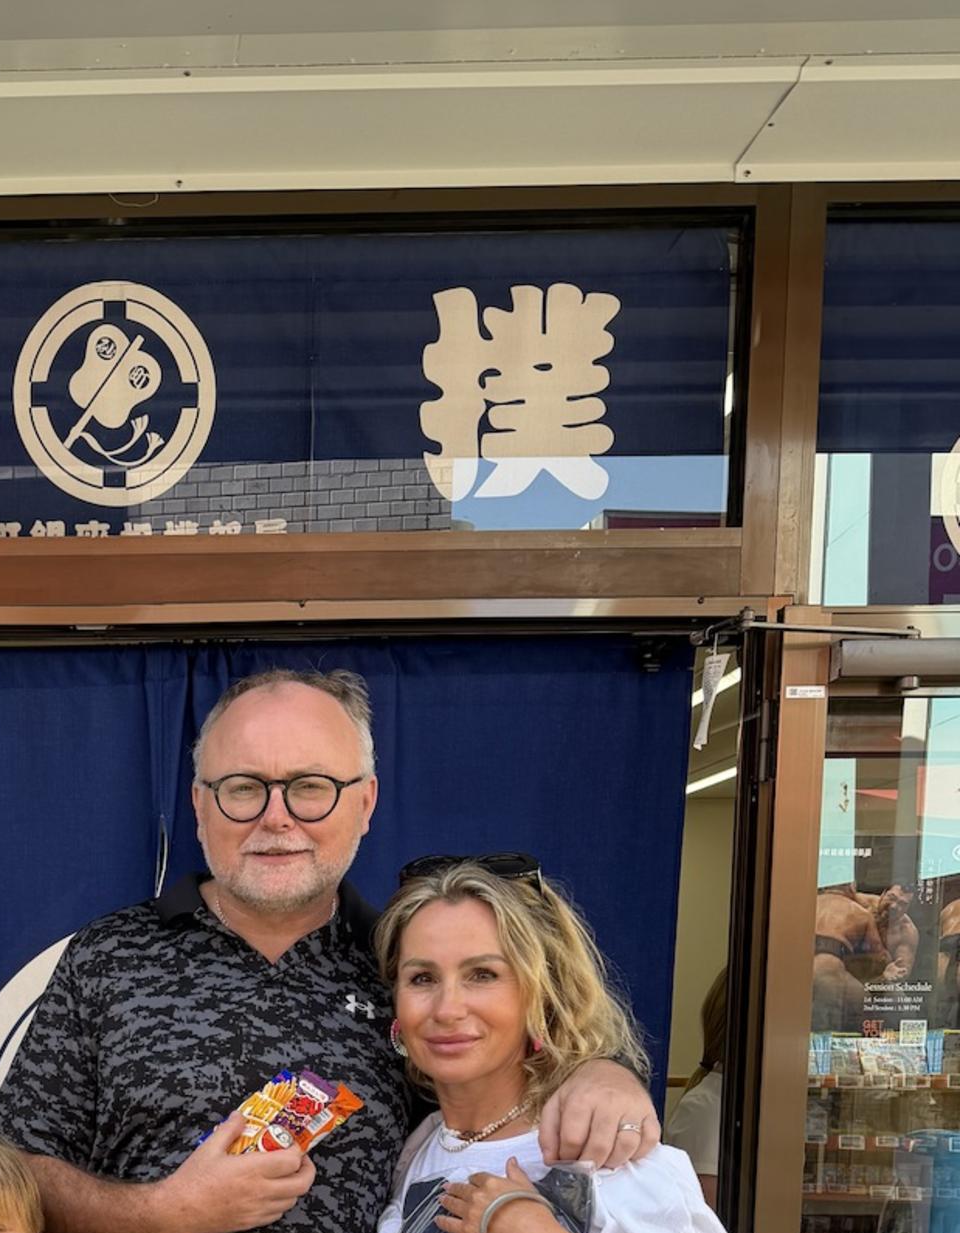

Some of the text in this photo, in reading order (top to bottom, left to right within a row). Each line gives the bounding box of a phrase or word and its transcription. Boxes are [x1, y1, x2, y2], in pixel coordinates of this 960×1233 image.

[419, 282, 622, 502] 撲
[864, 981, 933, 992] Session Schedule
